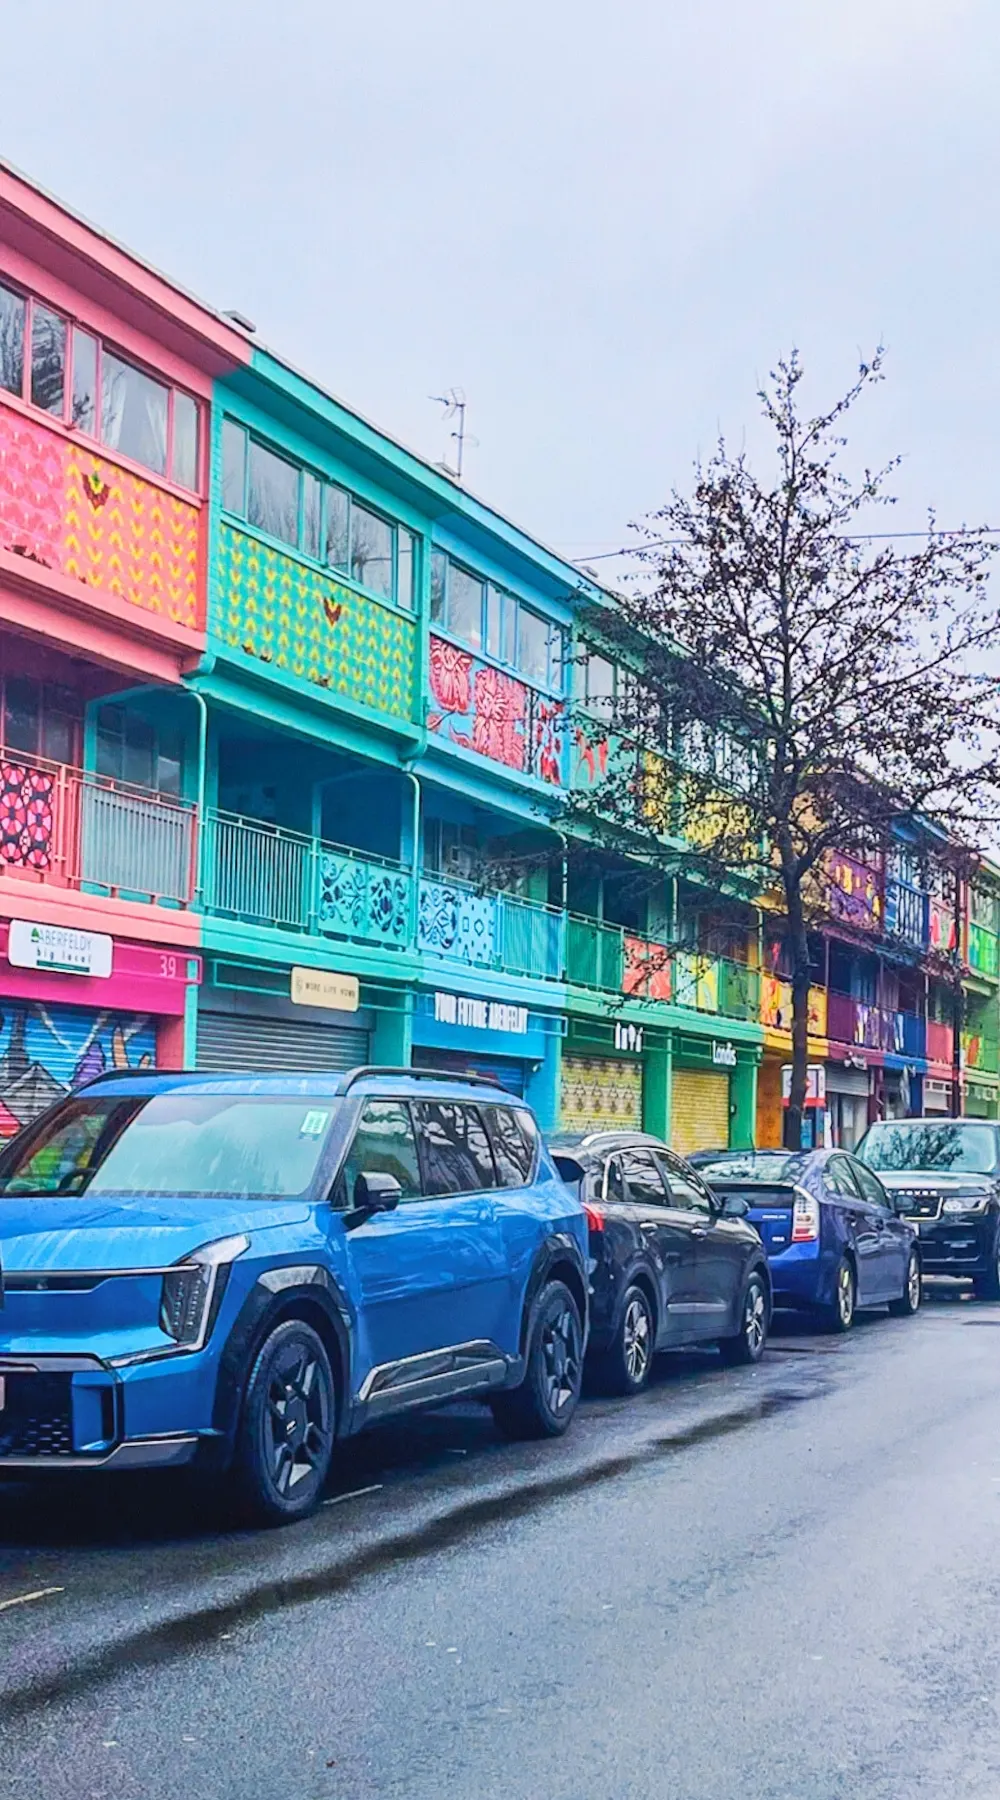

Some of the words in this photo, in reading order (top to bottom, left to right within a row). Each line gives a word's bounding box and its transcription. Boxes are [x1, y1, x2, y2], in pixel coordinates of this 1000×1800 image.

[38, 927, 94, 952] ABERFELDY
[36, 946, 55, 960] big
[61, 949, 92, 963] local
[160, 955, 176, 978] 39
